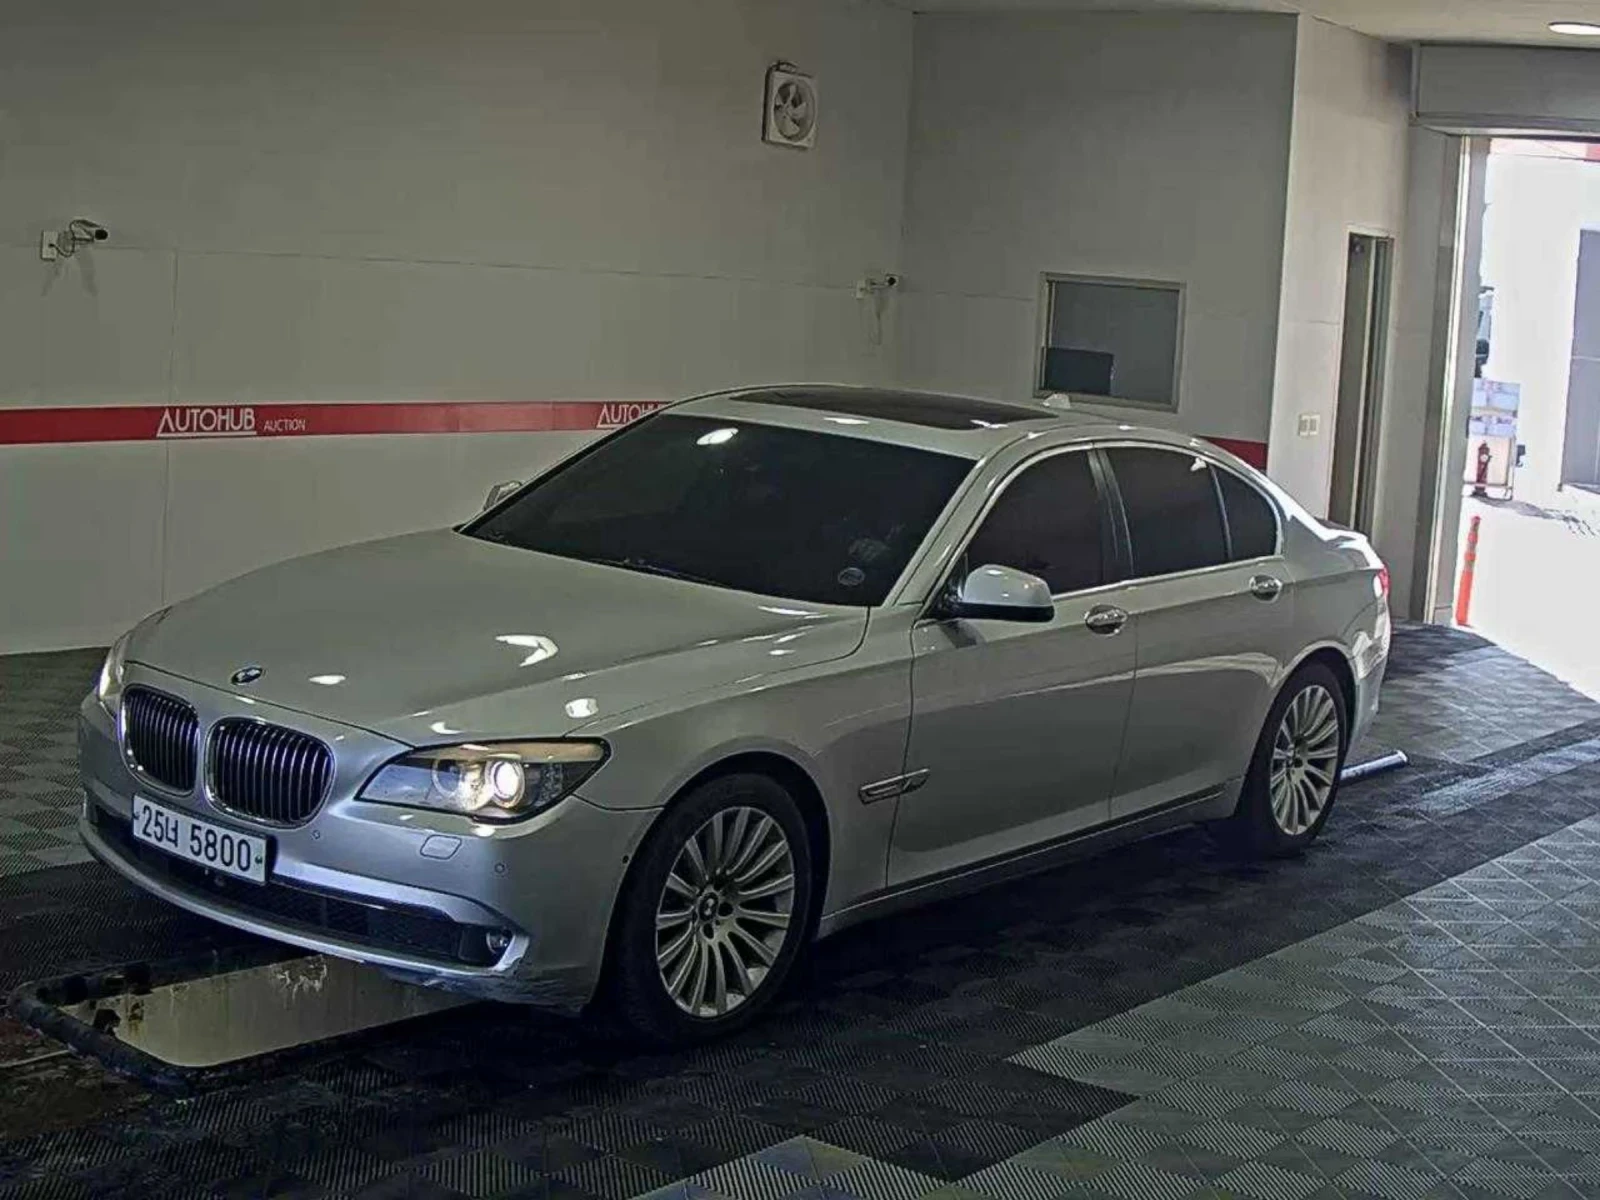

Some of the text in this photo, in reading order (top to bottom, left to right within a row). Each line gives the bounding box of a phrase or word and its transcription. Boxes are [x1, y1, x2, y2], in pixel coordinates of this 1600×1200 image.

[157, 408, 306, 437] AUTOHUB AUCTION
[189, 823, 251, 871] 5800
